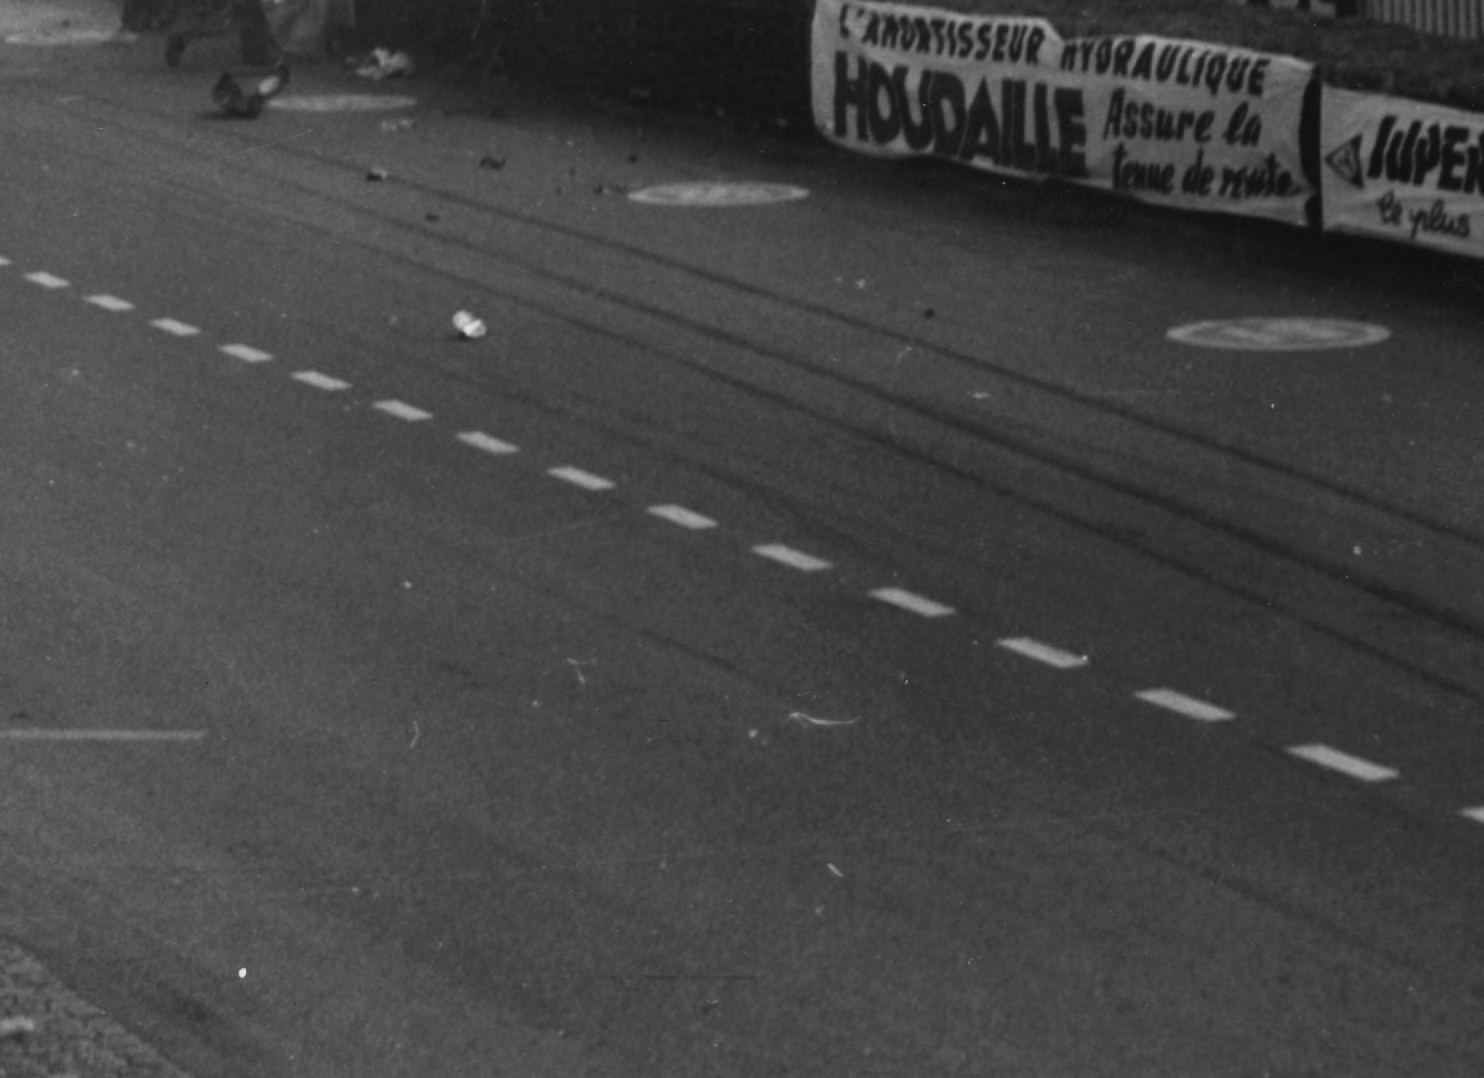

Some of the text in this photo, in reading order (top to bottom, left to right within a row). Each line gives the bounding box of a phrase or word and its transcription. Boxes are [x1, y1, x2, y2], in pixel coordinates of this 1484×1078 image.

[839, 4, 1271, 97] L'AMORTISSEUR HYDRAULIQUE
[834, 51, 1089, 179] HOUDAILLE
[1103, 87, 1262, 147] Assure la
[1112, 143, 1175, 195] tenue
[1182, 148, 1215, 197] de
[1409, 198, 1471, 240] plus
